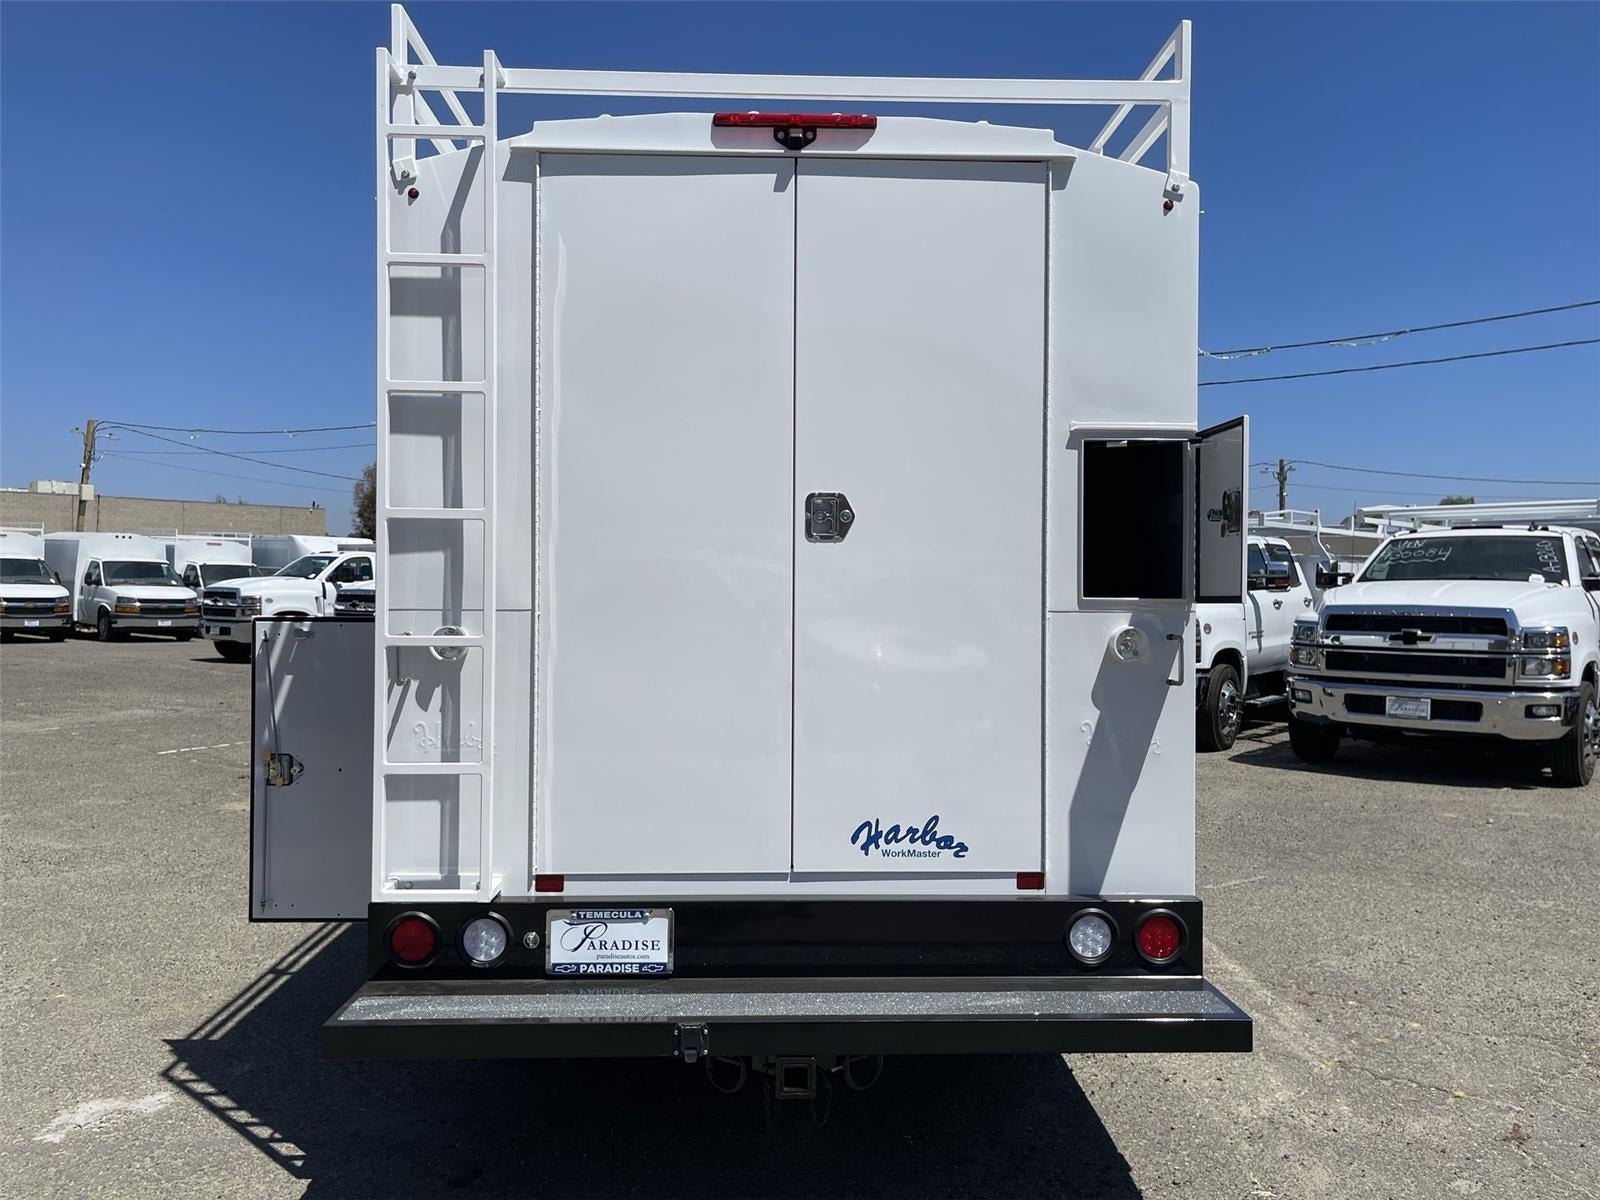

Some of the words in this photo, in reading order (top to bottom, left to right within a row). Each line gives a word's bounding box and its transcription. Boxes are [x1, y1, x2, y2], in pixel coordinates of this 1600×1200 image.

[850, 815, 969, 858] Harbor
[881, 849, 942, 858] WorkMaster
[578, 911, 642, 919] TEMECULA
[560, 920, 661, 952] PARADISE
[596, 953, 650, 961] paradiseautos.com
[579, 964, 640, 973] PARADISE
